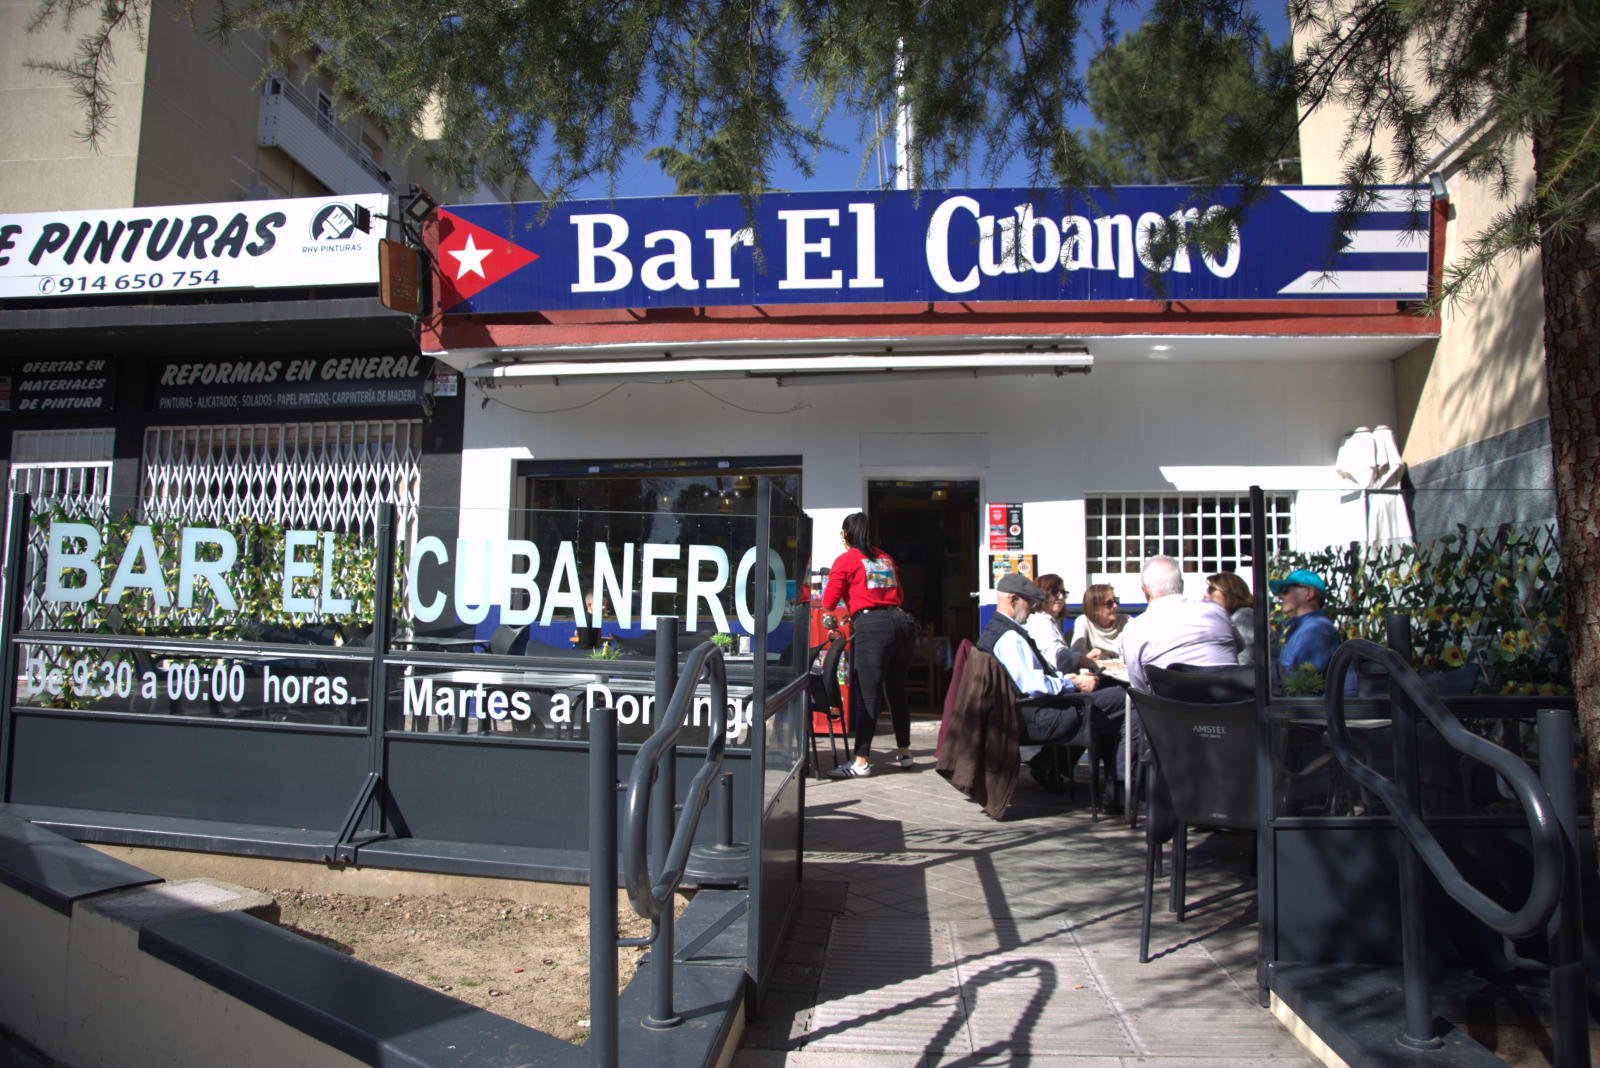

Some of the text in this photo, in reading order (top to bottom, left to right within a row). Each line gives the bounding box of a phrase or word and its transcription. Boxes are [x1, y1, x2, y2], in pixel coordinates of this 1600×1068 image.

[28, 212, 287, 266] PINTURAS
[302, 243, 362, 254] RHV PINTURAS
[569, 213, 755, 293] Bar
[777, 203, 884, 290] El
[59, 269, 220, 293] 914 650 754
[22, 360, 106, 374] OFERTAS EN
[160, 355, 420, 386] REFORMAS EN GENERAL
[19, 378, 106, 391] MATERIALES
[19, 396, 103, 410] DE PINTURA
[45, 522, 787, 635] BAR EL CUBANERO
[27, 658, 357, 706] De 9:30 a 00:00 horas.
[403, 677, 531, 722] Martes
[550, 691, 572, 724] a
